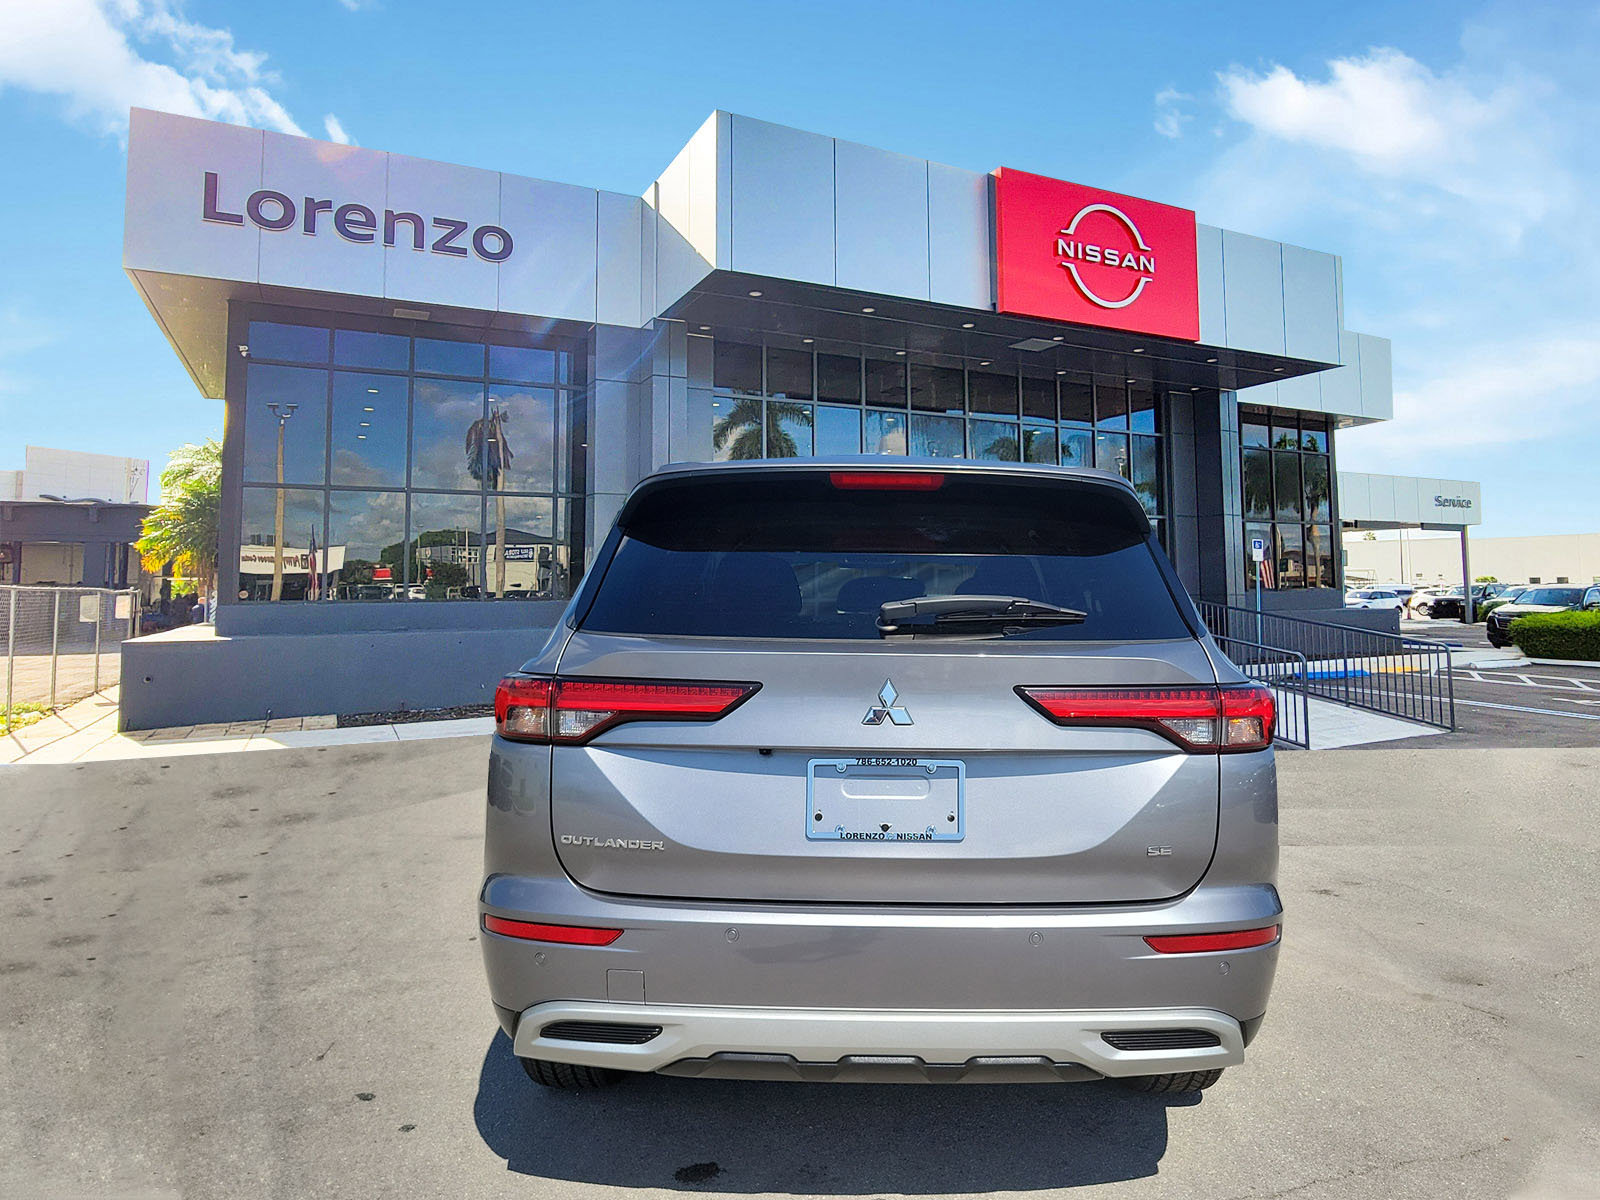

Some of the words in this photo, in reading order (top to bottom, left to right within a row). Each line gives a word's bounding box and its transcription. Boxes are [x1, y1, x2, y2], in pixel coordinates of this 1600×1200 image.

[202, 171, 514, 262] Lorenzo
[1057, 238, 1155, 273] NISSAN
[1434, 495, 1472, 509] Service
[856, 757, 918, 767] 786-652-1020
[560, 834, 665, 851] OUTLANDER
[839, 832, 885, 840] LORENZO
[896, 832, 933, 841] NISSAN
[1146, 845, 1172, 856] SE
